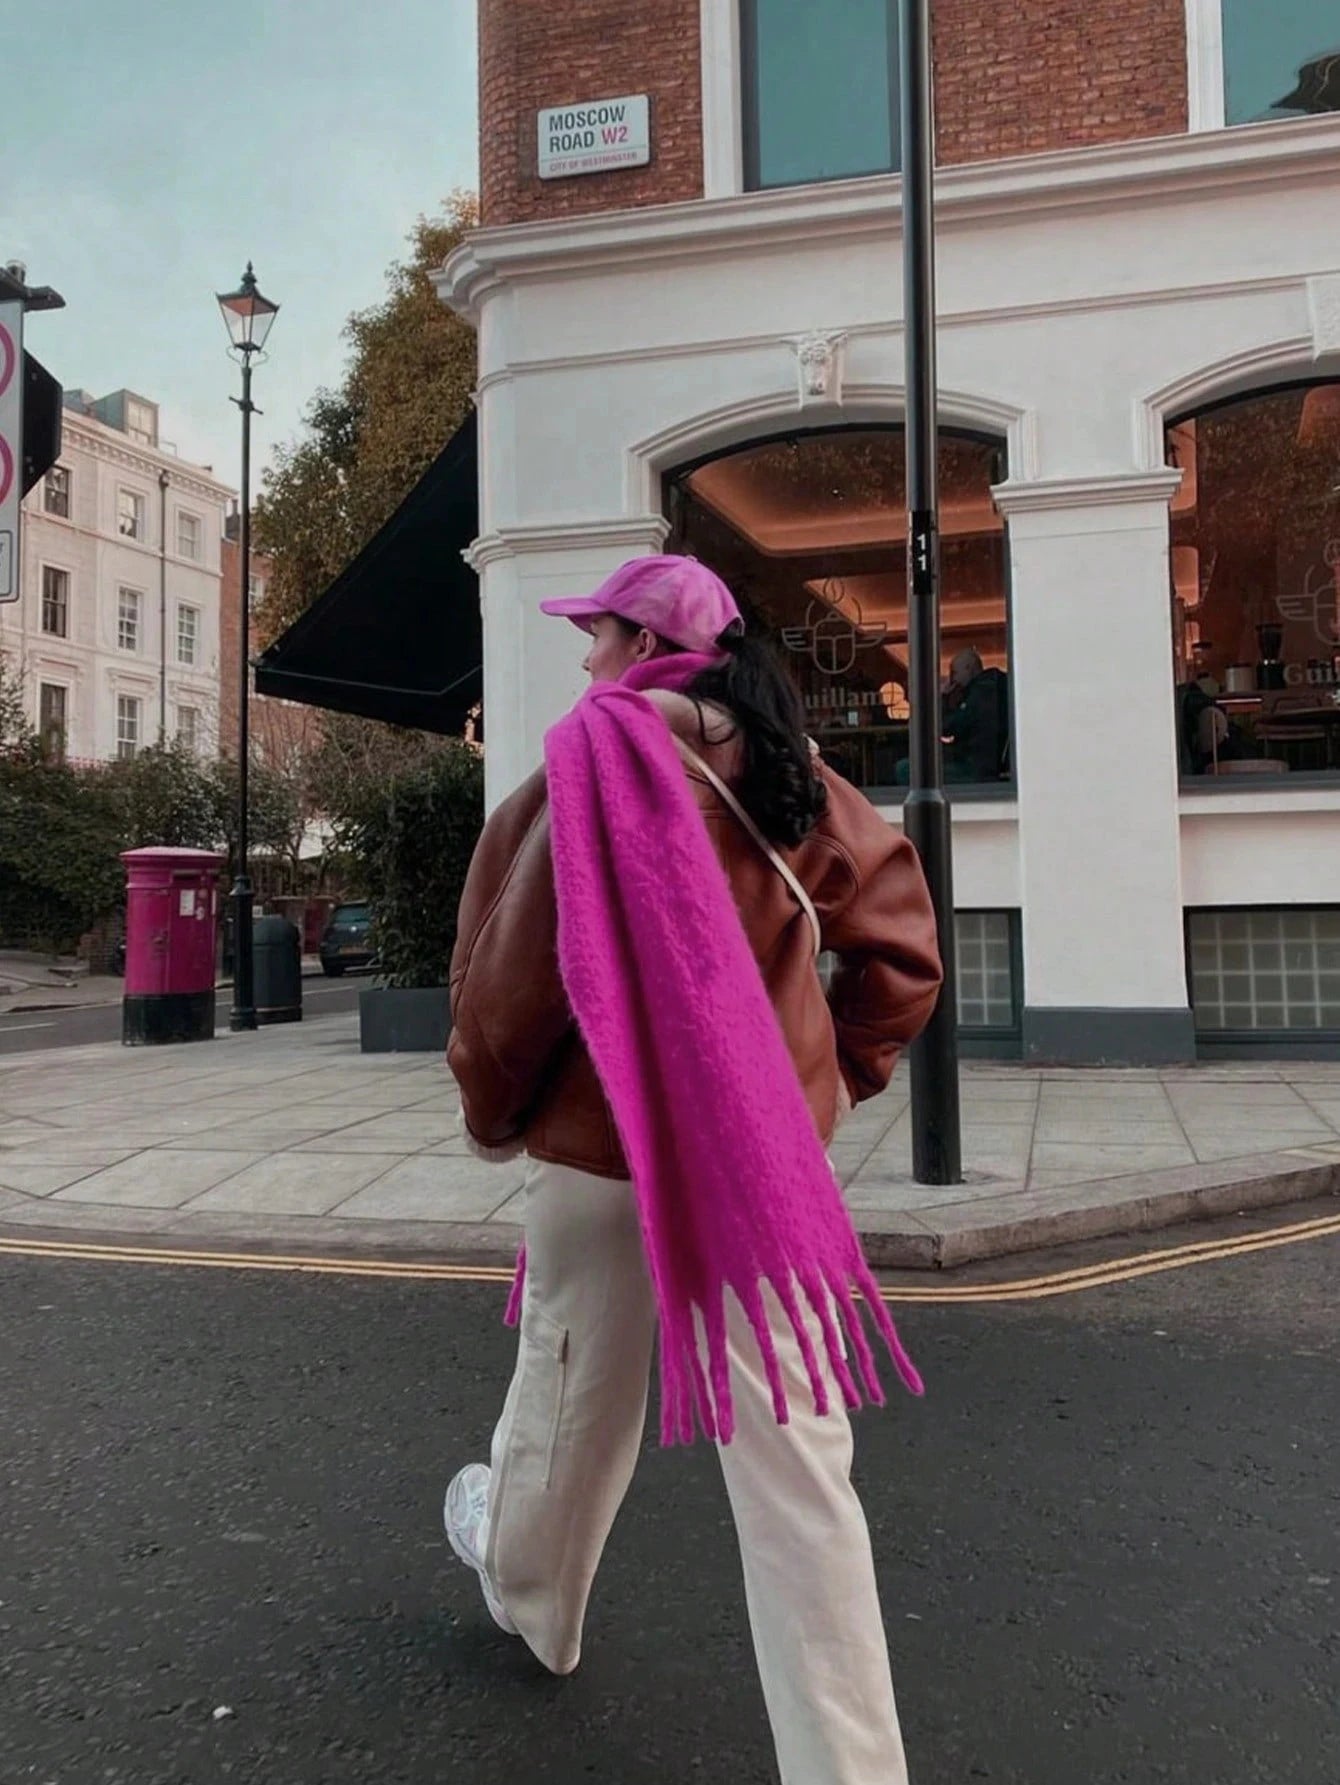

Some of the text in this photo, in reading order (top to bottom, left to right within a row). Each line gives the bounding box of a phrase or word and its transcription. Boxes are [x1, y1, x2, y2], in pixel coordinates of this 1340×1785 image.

[549, 105, 625, 132] MOSCOW
[549, 126, 628, 153] ROAD W2
